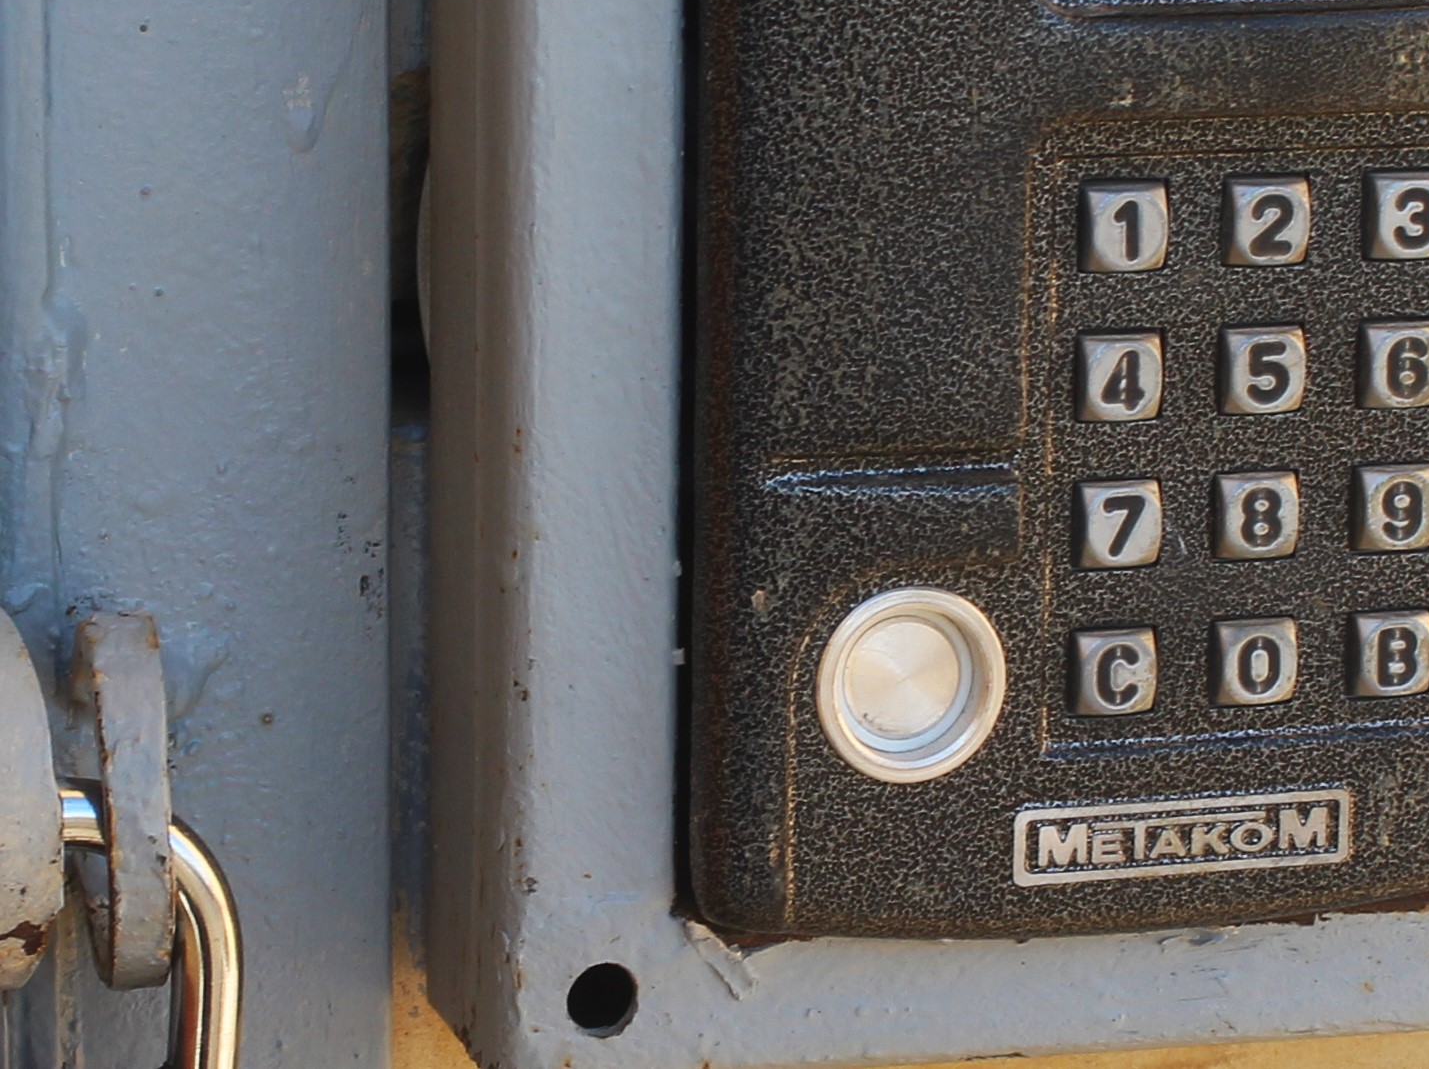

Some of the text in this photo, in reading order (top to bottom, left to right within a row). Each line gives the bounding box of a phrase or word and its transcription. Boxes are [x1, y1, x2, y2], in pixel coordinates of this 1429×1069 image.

[1113, 200, 1137, 262] 1
[1248, 194, 1293, 257] 2
[1102, 336, 1428, 412] 4 5 6
[1103, 481, 1424, 557] 7 8 9
[1096, 626, 1418, 706] C 0 B
